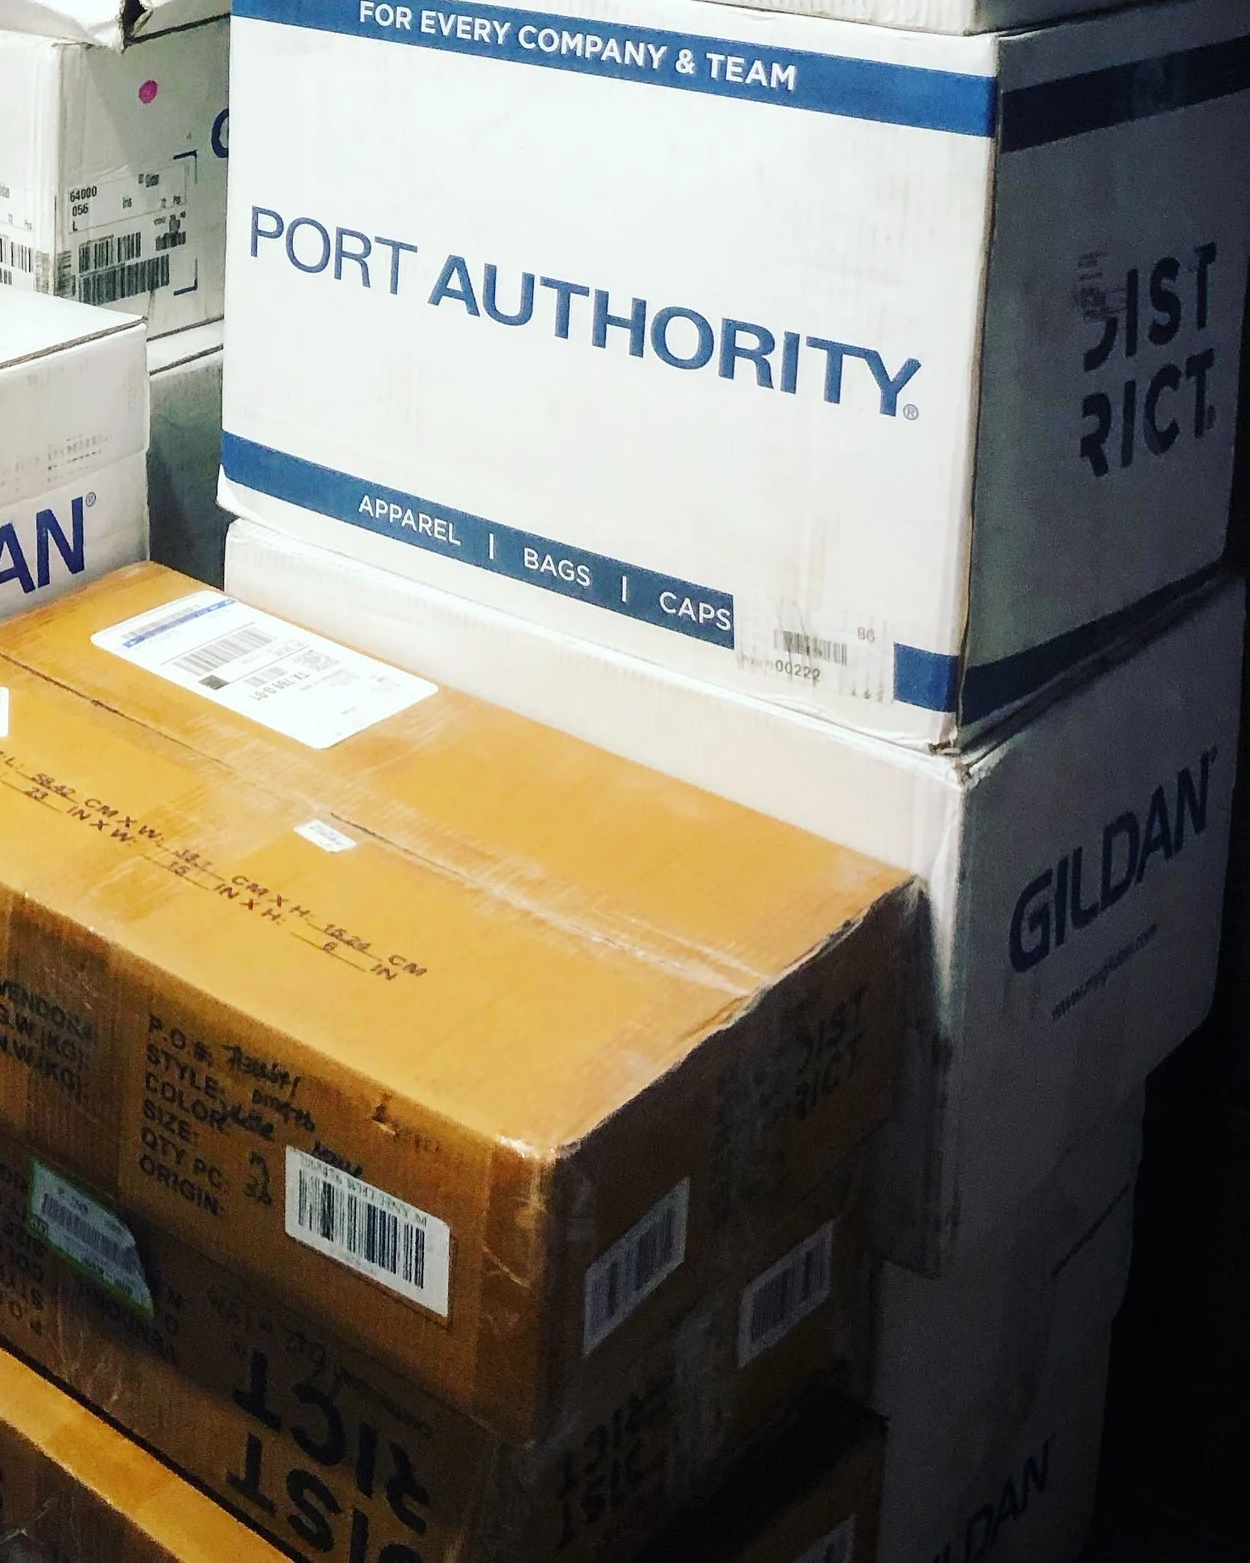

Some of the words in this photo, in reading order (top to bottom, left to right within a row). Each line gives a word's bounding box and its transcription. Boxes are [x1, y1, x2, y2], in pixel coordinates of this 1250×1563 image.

[358, 0, 411, 33] FOR
[421, 9, 511, 47] EVERY
[517, 21, 667, 74] COMPANY
[675, 49, 696, 75] &
[707, 53, 796, 93] TEAM
[70, 186, 97, 203] 64000
[249, 206, 419, 297] PORT
[427, 253, 922, 419] AUTHORITY
[358, 494, 462, 548] APPAREL
[523, 545, 592, 588] BAGS
[658, 590, 732, 633] CAPS
[84, 798, 119, 819] CM
[231, 874, 270, 897] CM
[388, 954, 427, 977] CM
[370, 964, 398, 981] IN
